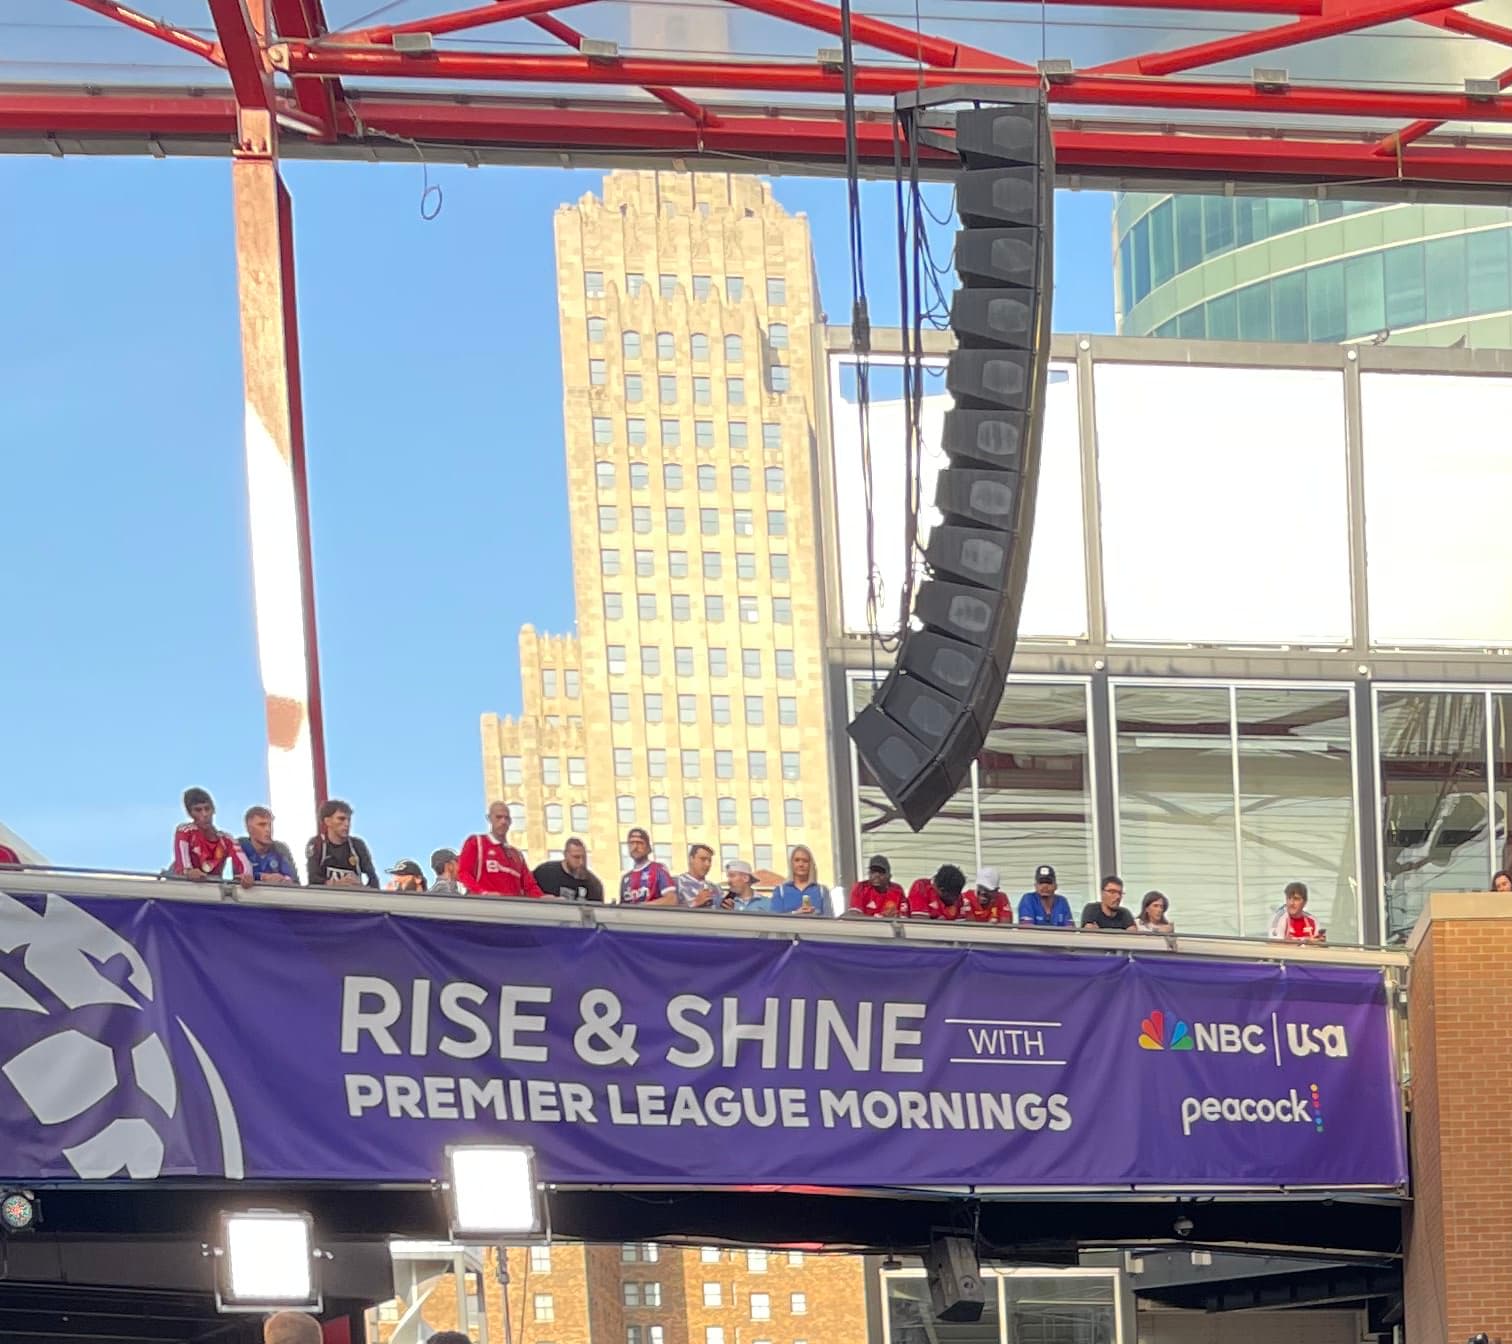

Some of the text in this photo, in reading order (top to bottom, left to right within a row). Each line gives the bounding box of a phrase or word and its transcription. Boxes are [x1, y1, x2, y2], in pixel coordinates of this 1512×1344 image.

[341, 976, 1045, 1073] RISE & SHINE WITH
[1194, 1022, 1266, 1054] NBC
[345, 1074, 1072, 1132] PREMIER LEAGUE MORNINGS
[1182, 1088, 1312, 1136] peacock
